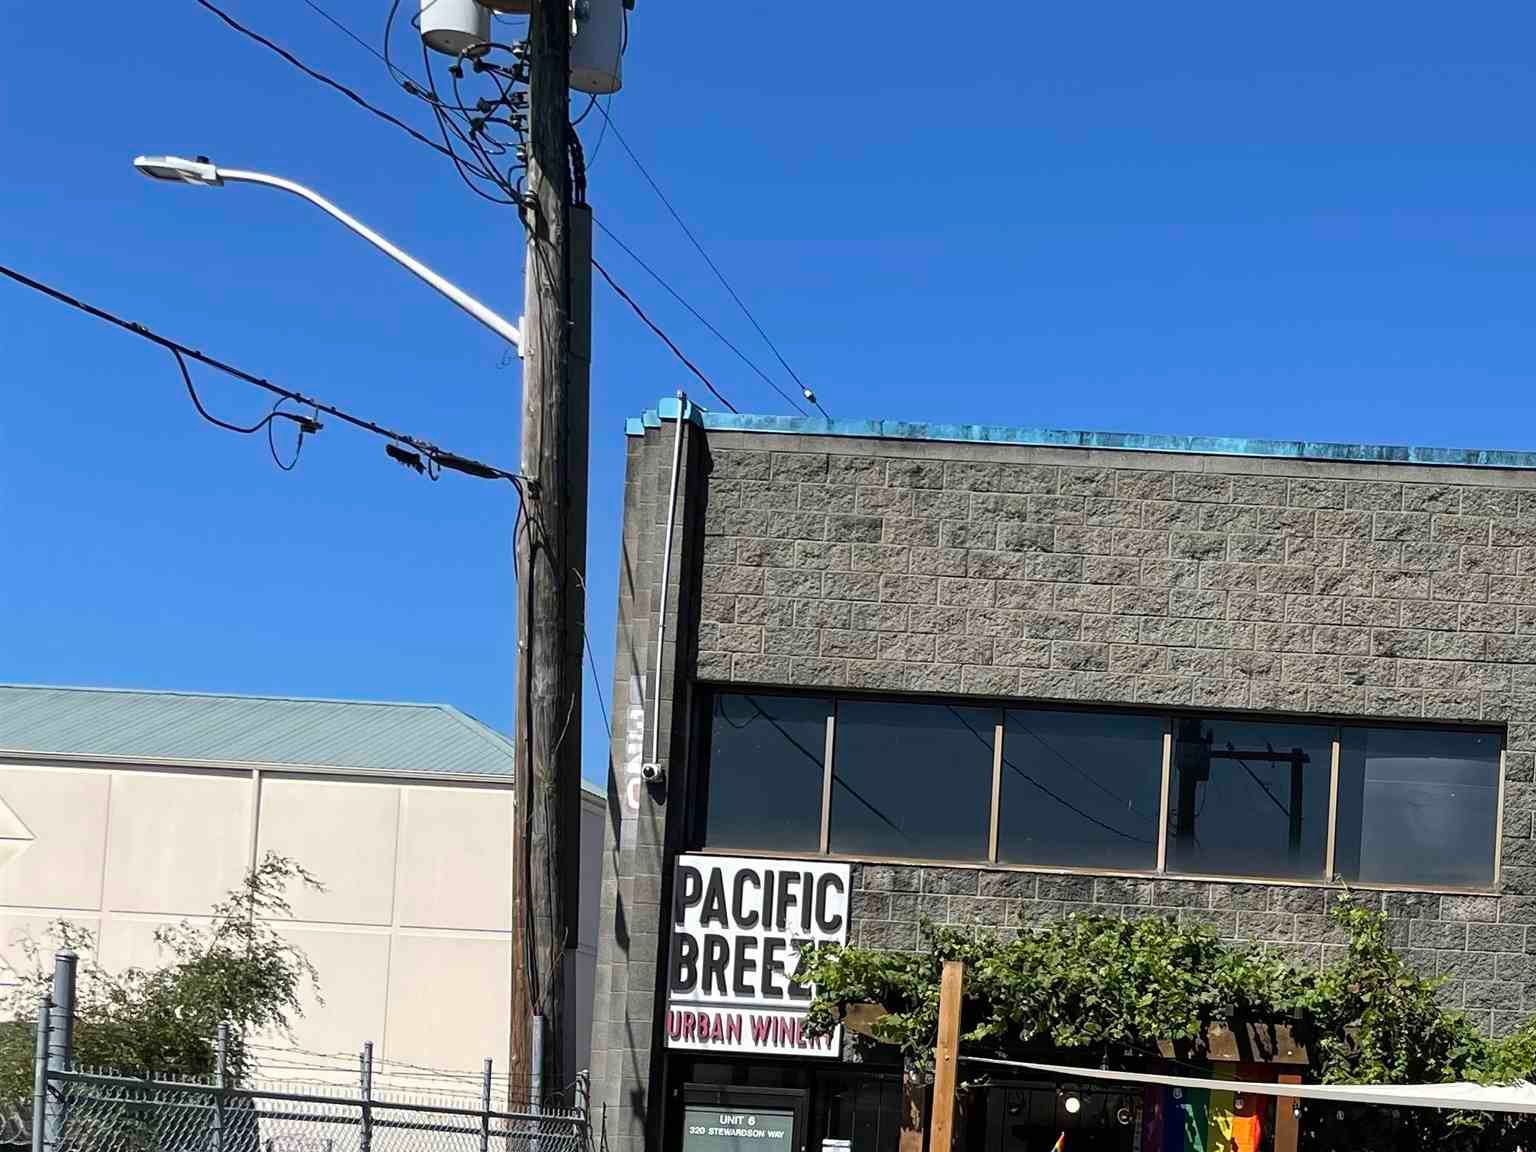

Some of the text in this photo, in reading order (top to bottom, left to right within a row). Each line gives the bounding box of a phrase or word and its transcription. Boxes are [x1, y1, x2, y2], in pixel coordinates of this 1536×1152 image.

[675, 865, 844, 934] PACIFIC
[671, 931, 841, 1000] BREEZ
[667, 1010, 742, 1045] URBAN
[689, 1126, 785, 1138] 320 STEWARDSON WAY
[720, 1114, 744, 1125] UNIT
